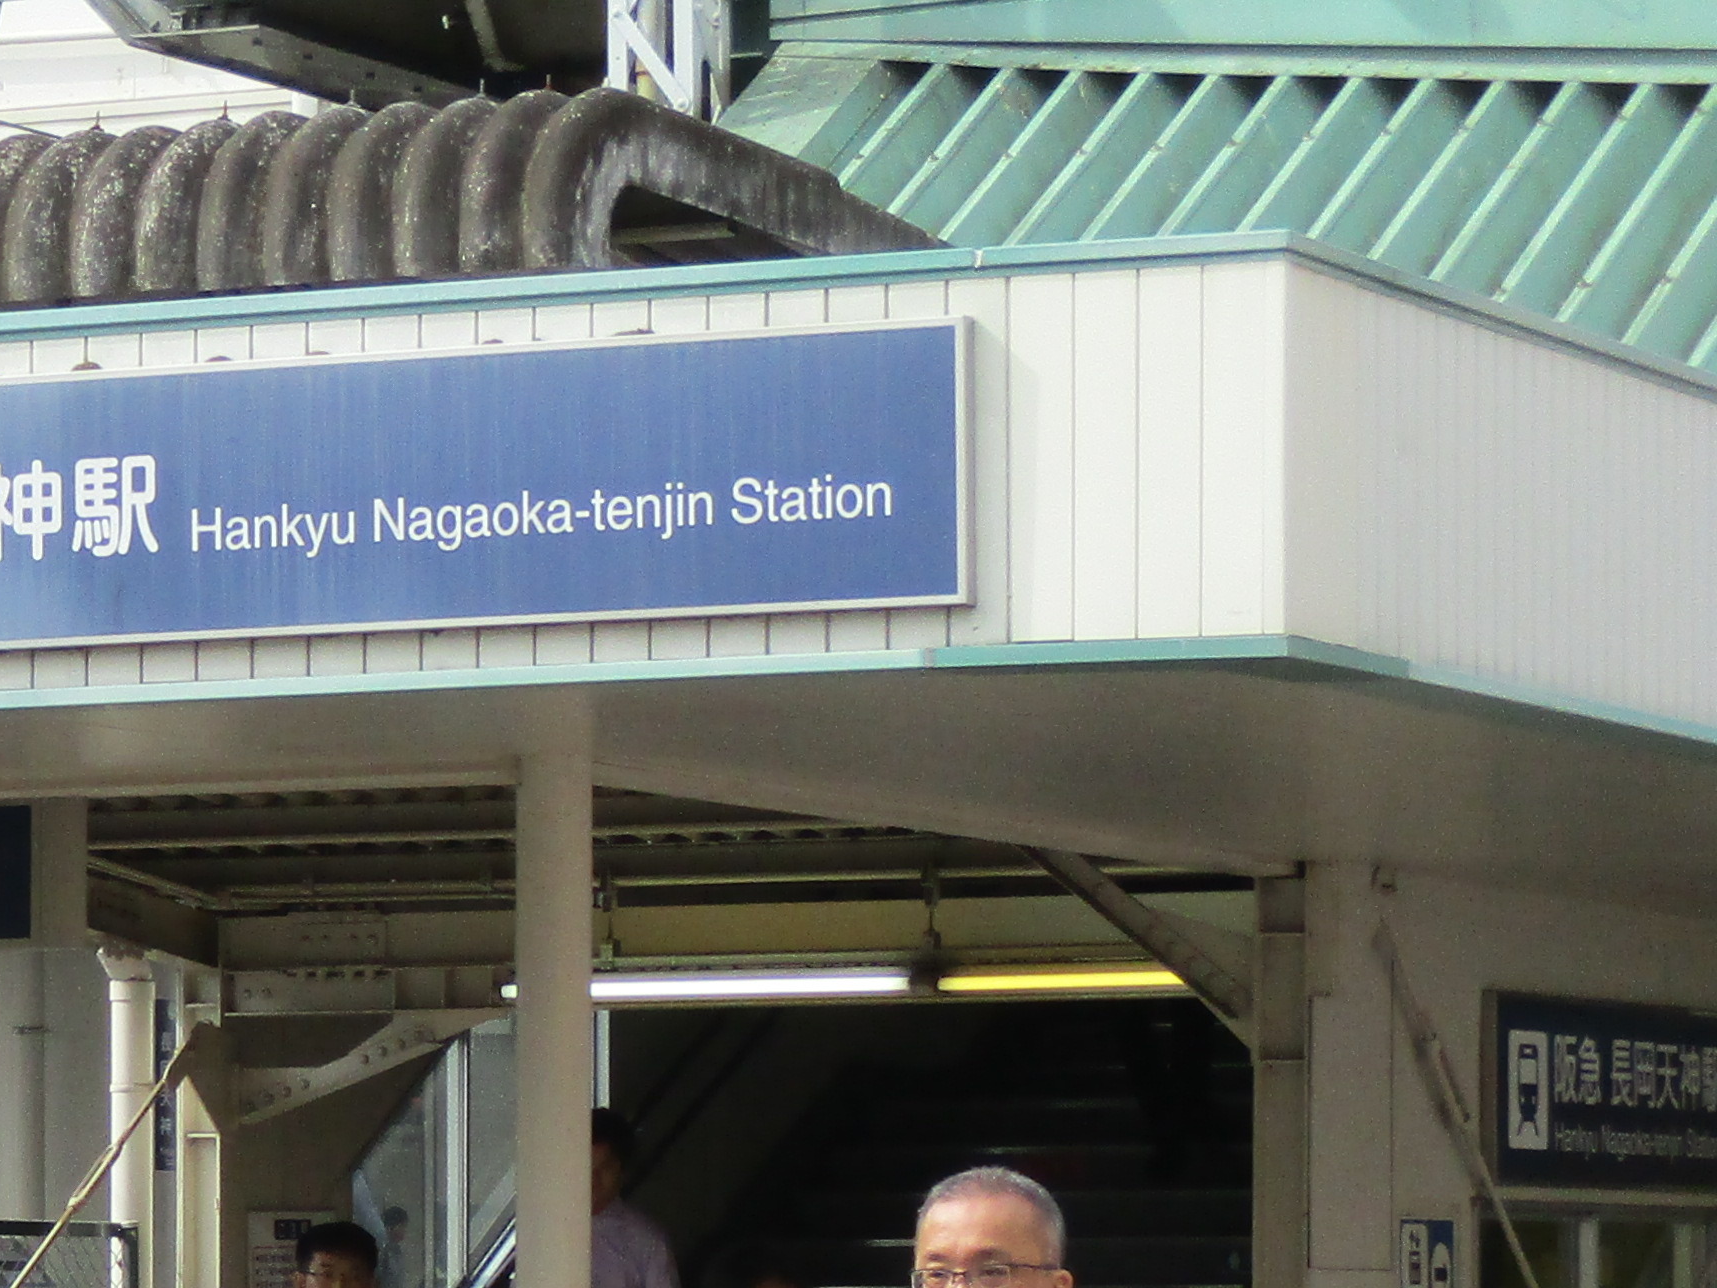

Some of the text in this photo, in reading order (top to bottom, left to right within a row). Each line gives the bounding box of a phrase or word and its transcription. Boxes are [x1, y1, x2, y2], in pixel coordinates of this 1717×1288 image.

[190, 474, 892, 558] Hankyu Nagaoka-tenjin Station
[1553, 1034, 1602, 1105] 阪急
